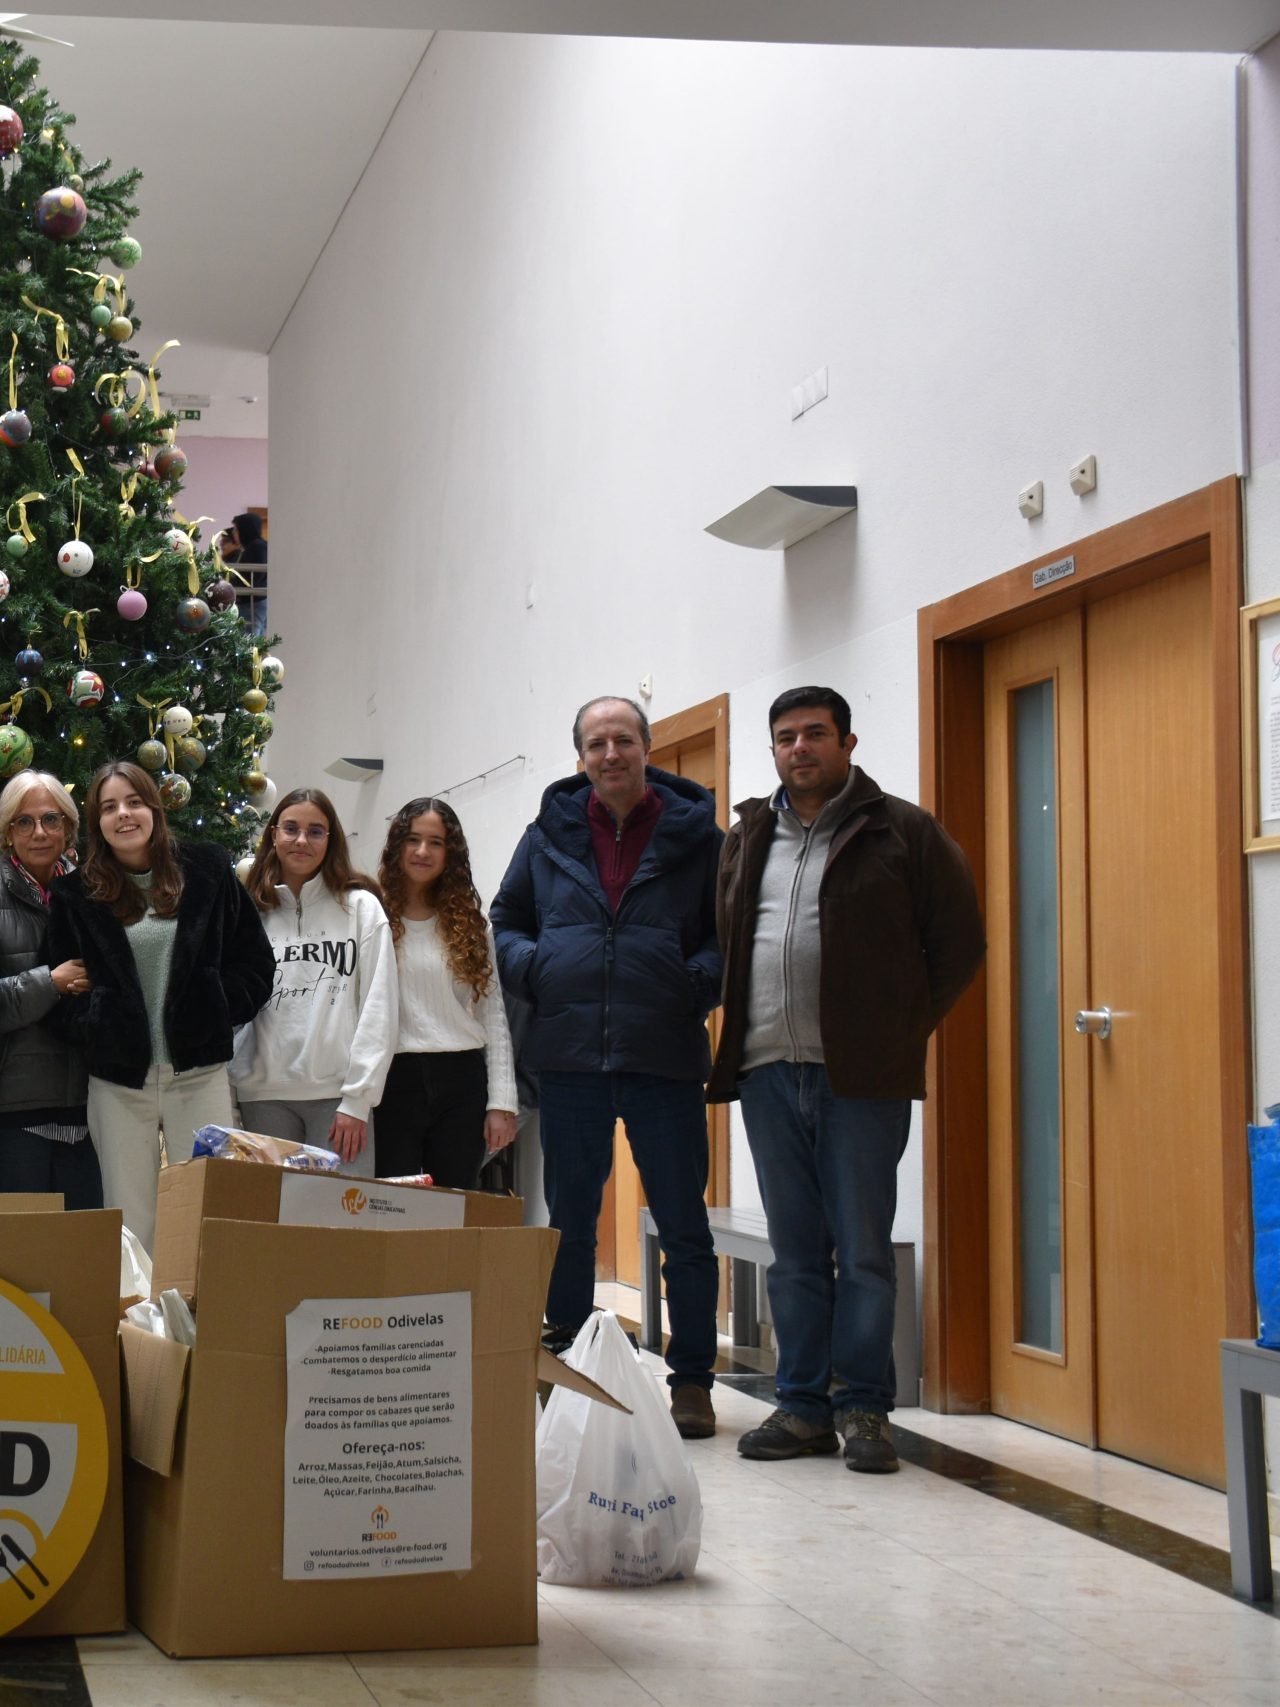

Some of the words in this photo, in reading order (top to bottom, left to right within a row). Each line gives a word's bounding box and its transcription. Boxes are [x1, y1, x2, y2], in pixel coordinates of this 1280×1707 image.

[323, 1317, 383, 1330] REFOOD
[387, 1312, 444, 1329] Odivelas
[315, 1344, 359, 1354] -Apoiamos
[397, 1339, 444, 1350] carenciadas
[300, 1355, 360, 1365] -Combatemos
[418, 1350, 457, 1361] alimentar
[328, 1367, 384, 1377] -Resgatamos
[385, 1366, 401, 1375] boa
[402, 1363, 431, 1373] comida
[309, 1395, 361, 1405] Precisamos
[363, 1395, 375, 1404] de
[376, 1394, 398, 1403] bens
[399, 1390, 450, 1402] alimentares
[304, 1409, 326, 1419] para
[328, 1408, 364, 1419] compor
[378, 1406, 412, 1416] cabazes
[414, 1405, 430, 1415] que
[432, 1402, 455, 1412] serão
[304, 1420, 338, 1430] doados
[340, 1420, 351, 1429] às
[391, 1419, 407, 1428] que
[409, 1415, 453, 1427] apoiamos.
[342, 1440, 425, 1455] Ofereça-nos:
